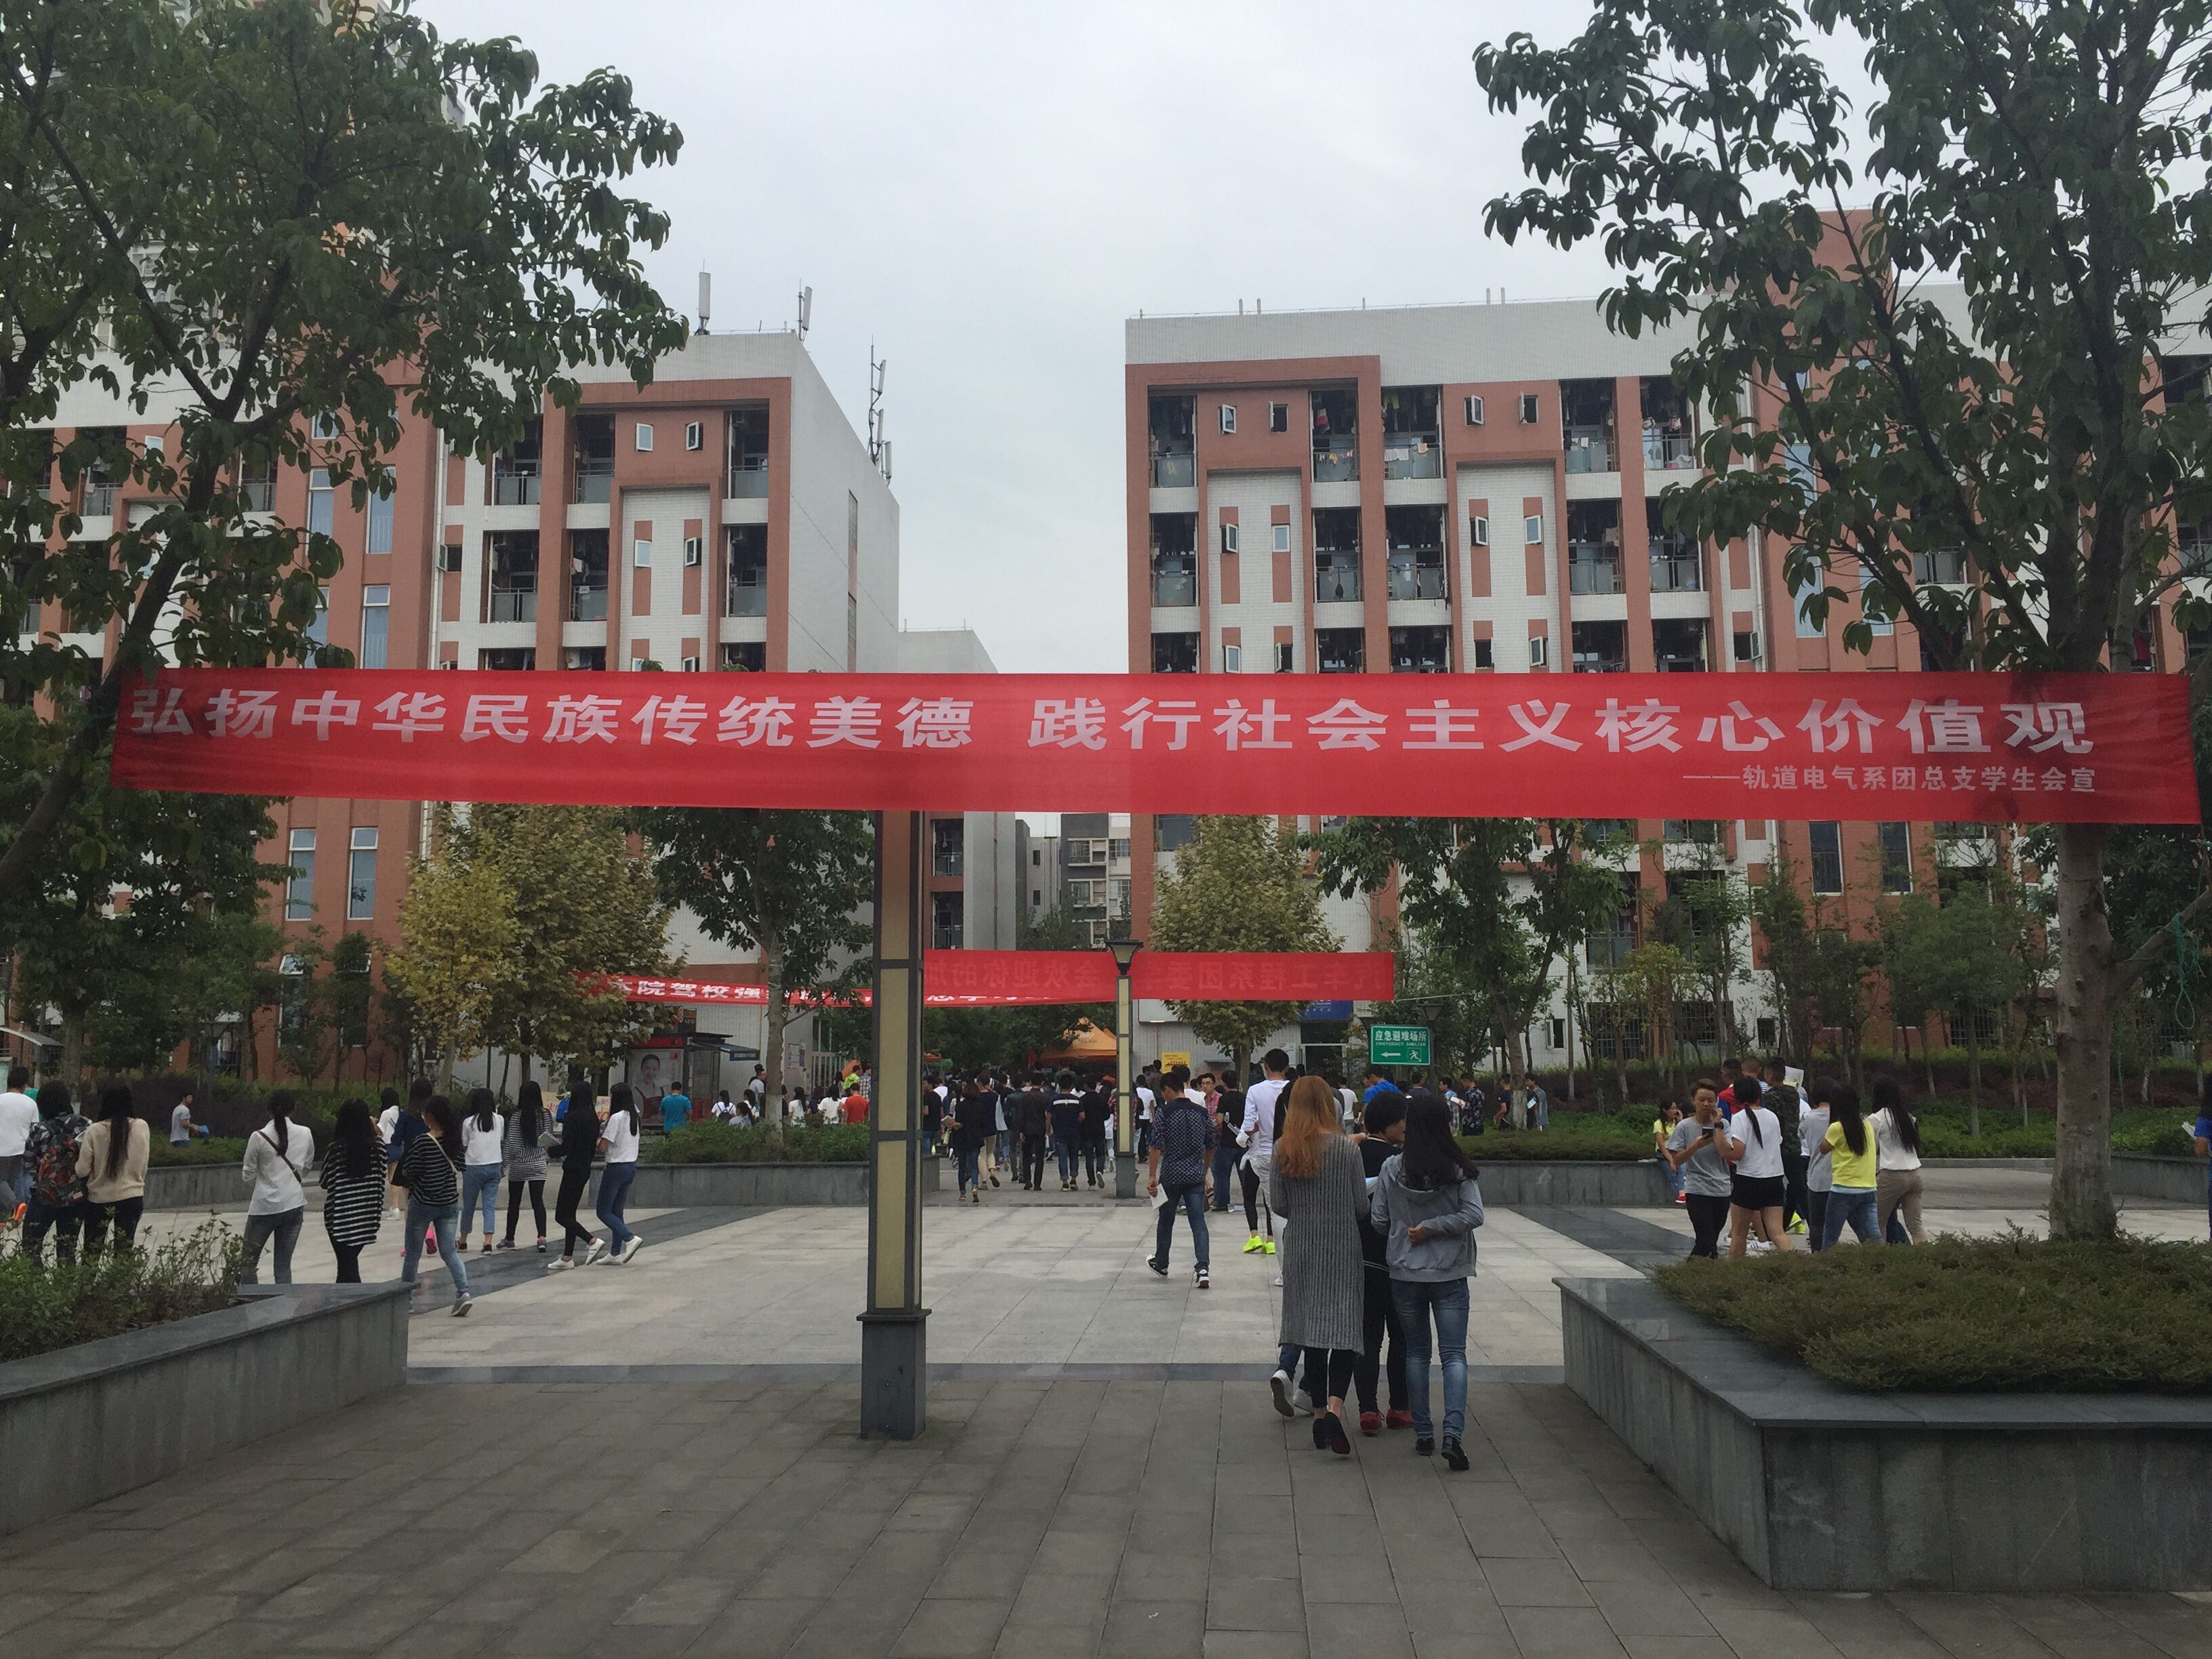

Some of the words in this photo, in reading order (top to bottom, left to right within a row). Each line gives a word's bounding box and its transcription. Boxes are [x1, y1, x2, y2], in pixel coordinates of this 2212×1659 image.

[129, 687, 975, 749] 弘扬中华民族传统美德
[1027, 697, 2095, 754] 践行社会主义核心价值观
[1375, 1030, 1427, 1041] 应急避难场所
